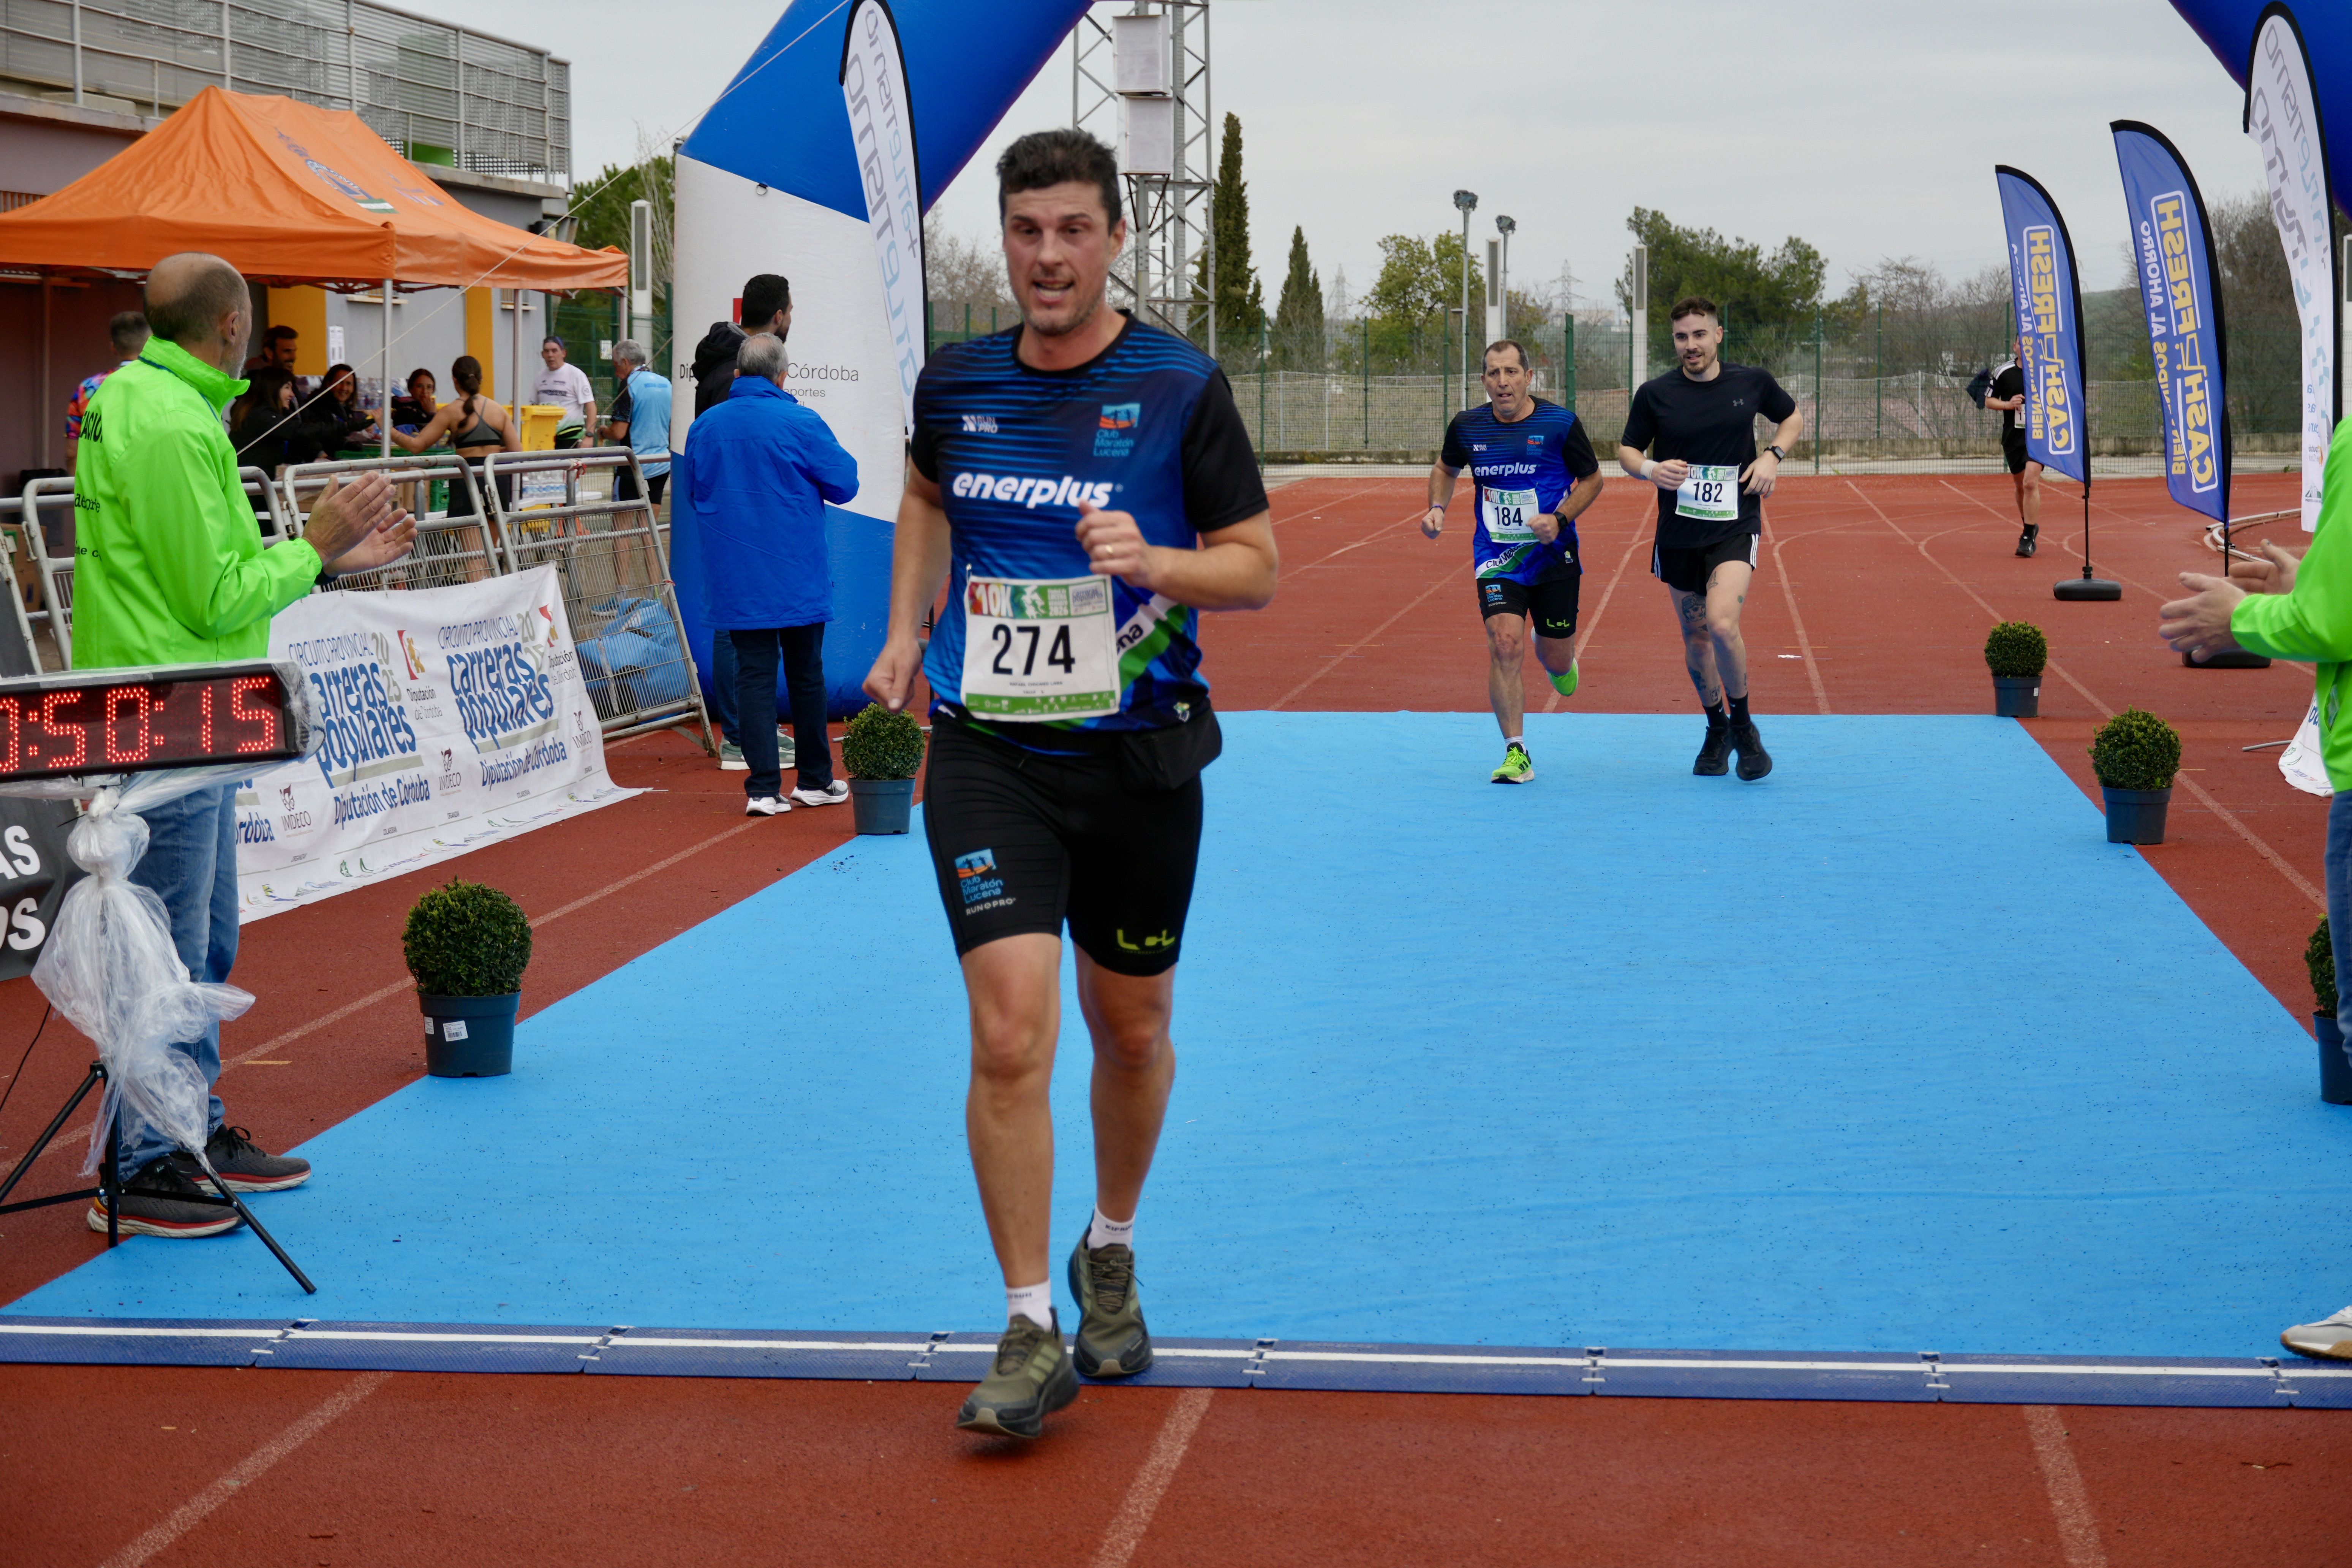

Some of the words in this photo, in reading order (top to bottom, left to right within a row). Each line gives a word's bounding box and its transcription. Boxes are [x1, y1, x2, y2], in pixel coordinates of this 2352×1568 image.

[787, 362, 858, 381] Córdoba
[783, 387, 826, 397] eportes
[977, 415, 996, 424] RUN
[978, 424, 999, 434] PRO
[1474, 462, 1538, 477] enerplus
[952, 472, 1113, 509] enerplus
[1487, 489, 1501, 504] 10K
[1693, 482, 1723, 503] 182
[1494, 506, 1523, 526] 184
[975, 583, 1014, 618] 10K
[438, 622, 472, 650] CIRCUITO
[471, 614, 518, 645] PROVINCIAL
[517, 610, 536, 643] 20
[289, 638, 327, 667] CIRCUITO
[327, 632, 374, 663] PROVINCIAL
[372, 632, 389, 665] 20
[992, 623, 1076, 676] 274
[381, 669, 402, 702] 25
[446, 641, 536, 699] carreras
[310, 662, 388, 719] arreras
[406, 686, 437, 702] Diputación
[455, 673, 555, 754] populares
[316, 704, 417, 789] populares
[481, 751, 523, 792] Diputación
[531, 737, 568, 772] Córdoba
[334, 783, 387, 830] Diputación
[382, 782, 398, 809] de
[396, 773, 431, 806] Córdoba
[281, 811, 311, 831] IMDECO
[961, 875, 981, 888] Club
[962, 878, 1004, 895] Maratón
[964, 888, 1001, 904] Lucena
